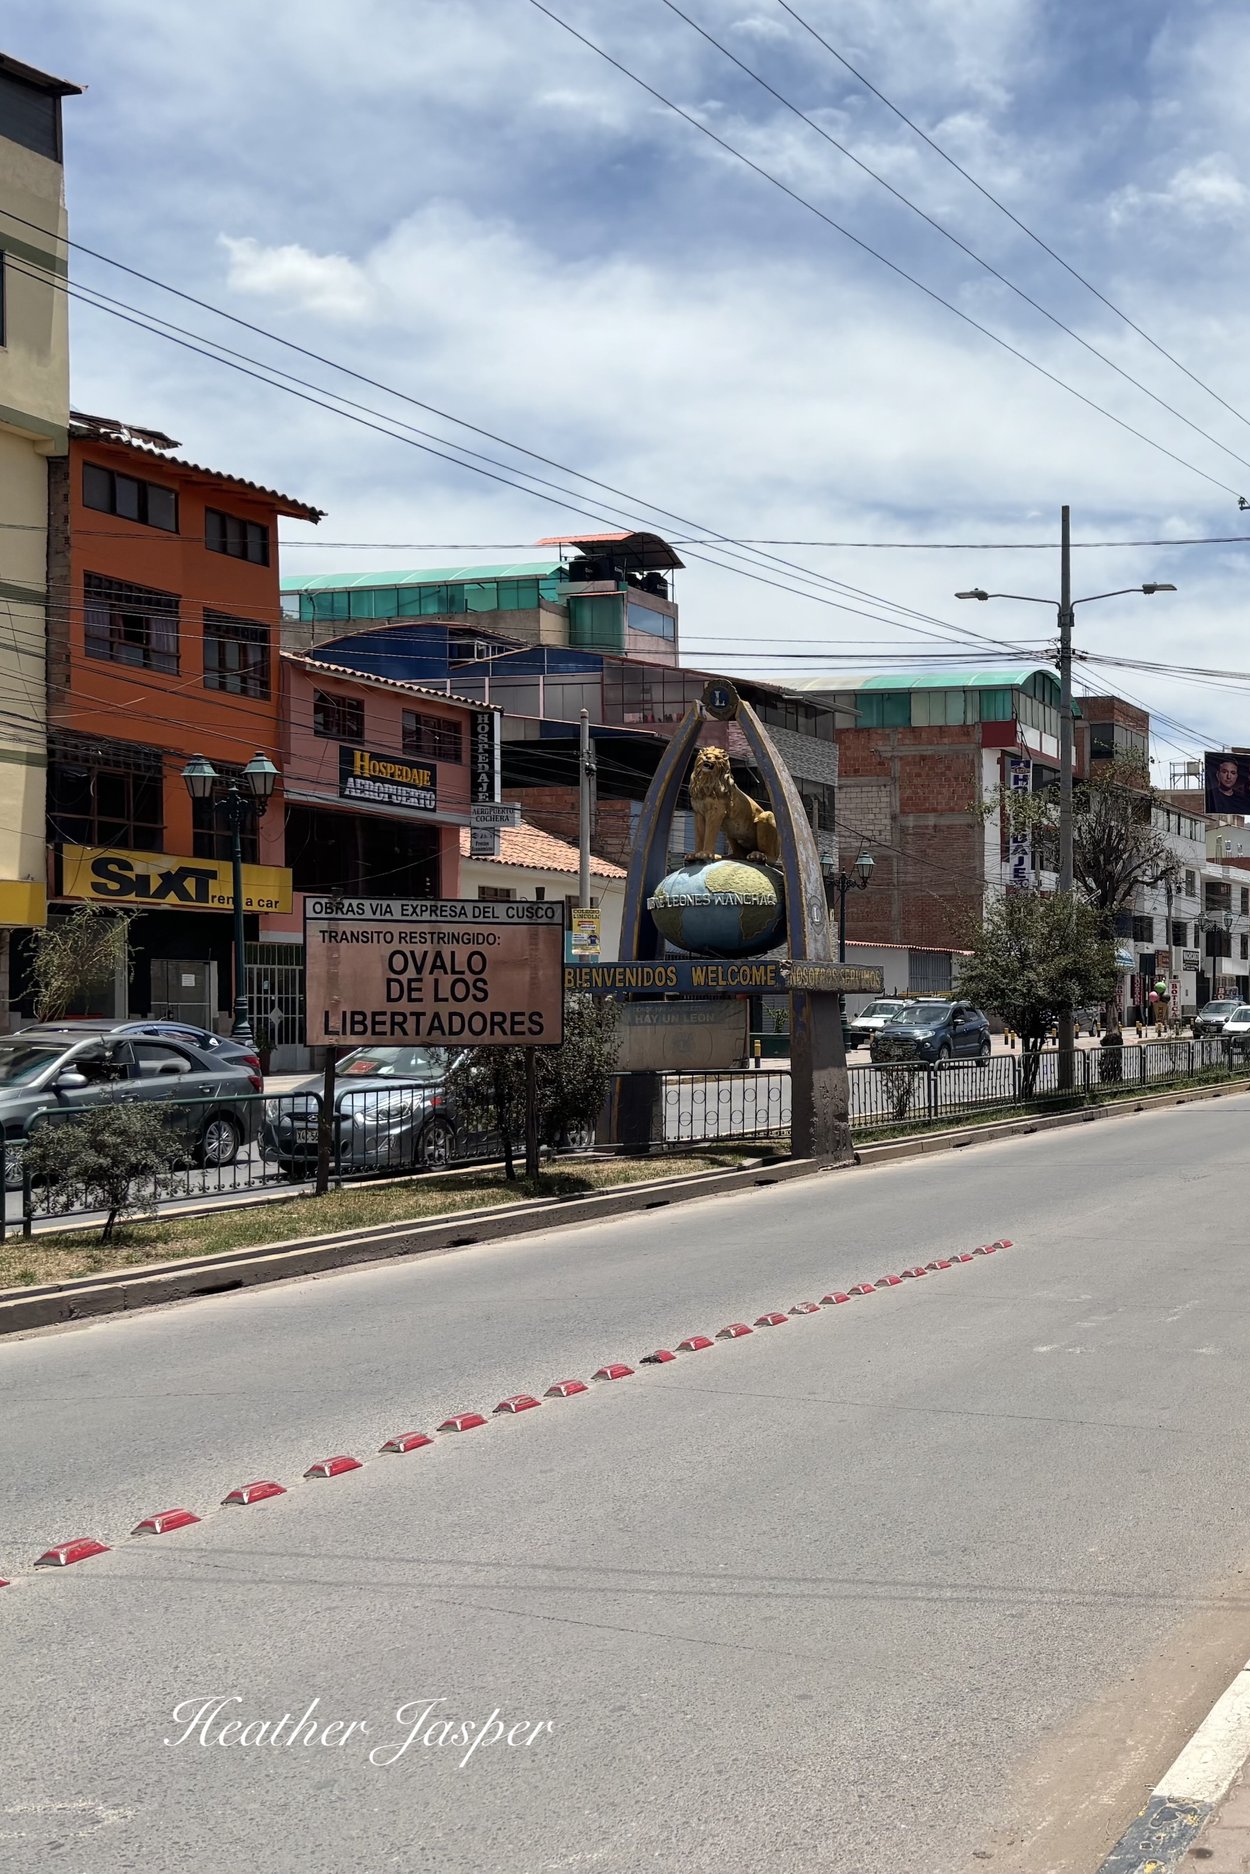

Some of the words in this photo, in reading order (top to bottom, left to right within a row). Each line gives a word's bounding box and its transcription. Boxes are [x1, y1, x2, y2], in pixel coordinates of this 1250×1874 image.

[477, 714, 490, 802] HOSPEDAJE
[344, 777, 436, 809] AEROPUERTO
[472, 807, 515, 816] AEROPUERTO
[475, 814, 510, 823] COCHERA
[1011, 774, 1028, 879] HDAJE
[90, 856, 218, 904] SIXT
[211, 894, 235, 906] ren
[245, 896, 253, 907] a
[257, 897, 280, 909] car
[312, 901, 365, 916] OBRAS
[369, 903, 394, 916] VIA
[400, 903, 468, 918] EXPRESA
[472, 905, 499, 919] DEL
[505, 906, 556, 919] CUSCO
[667, 892, 711, 908] LEONES
[714, 892, 778, 907] WANCHAQ
[319, 929, 394, 945] TRANSITO
[398, 930, 501, 946] RESTRINGIDO:
[387, 949, 488, 976] OVALO
[564, 966, 677, 988] BIENVENIDOS
[691, 965, 777, 986] WELCOME
[789, 966, 840, 986] NOSOTROS
[386, 977, 423, 1003] DE
[434, 977, 490, 1003] LOS
[323, 1010, 545, 1036] LIBERTADORES
[635, 1013, 659, 1024] HAY
[662, 1013, 678, 1023] UN
[684, 1012, 715, 1022] LEON
